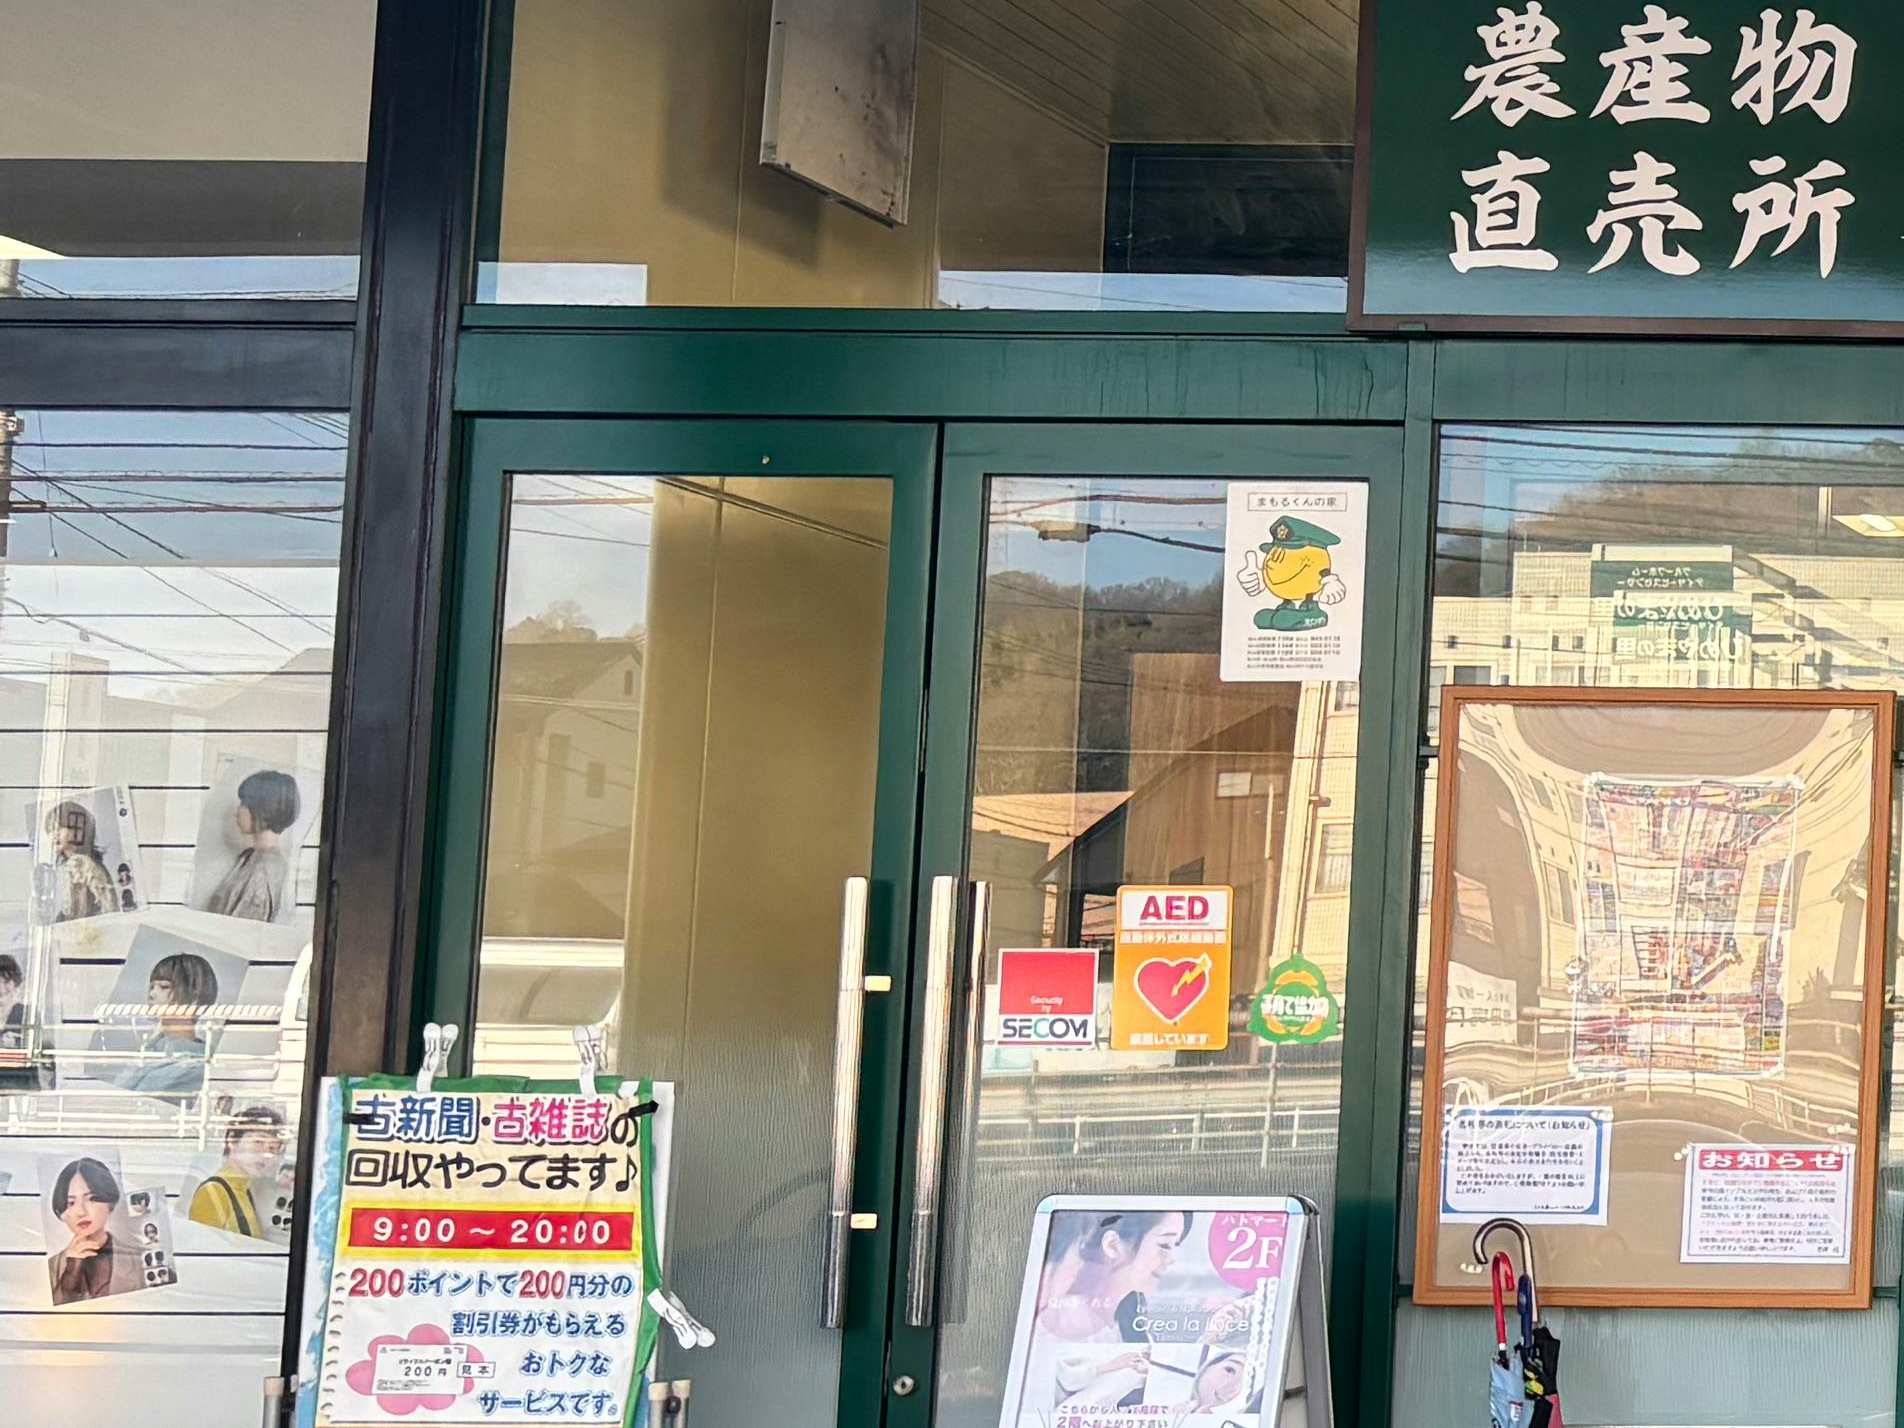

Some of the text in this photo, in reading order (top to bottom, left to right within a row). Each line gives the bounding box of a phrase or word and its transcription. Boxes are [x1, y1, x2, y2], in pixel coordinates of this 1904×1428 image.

[1453, 4, 1860, 122] 農産物
[1445, 155, 1853, 280] 直売所
[1257, 497, 1338, 508] まもるくんの家
[1140, 895, 1210, 920] AED
[1002, 1018, 1088, 1039] SECOM
[1703, 1151, 1841, 1169] お知らせ
[1223, 1226, 1283, 1270] 2F
[348, 1268, 633, 1300] 200ポイントで200円分の
[450, 1309, 627, 1339] 割引券がもらえる
[461, 1364, 490, 1375] 見本
[520, 1349, 612, 1376] おトクな
[478, 1390, 622, 1418] サービスです。
